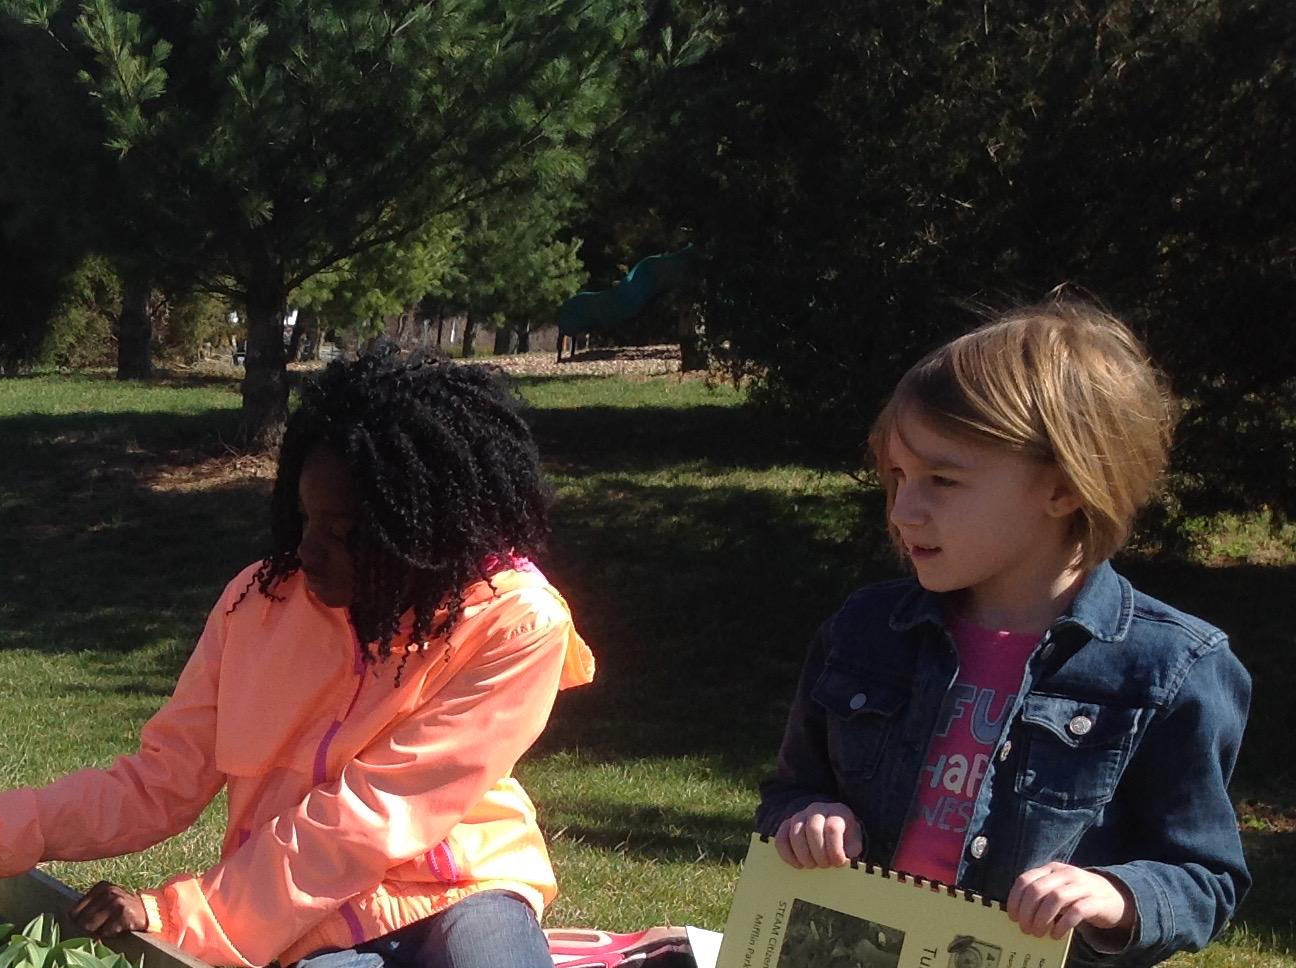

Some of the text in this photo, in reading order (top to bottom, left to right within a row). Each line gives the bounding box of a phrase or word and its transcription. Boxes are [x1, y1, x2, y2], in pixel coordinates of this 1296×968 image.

[748, 913, 764, 946] Mifflin
[772, 900, 787, 936] STEAM
[742, 947, 755, 968] Park
[761, 936, 778, 968] Citizen
